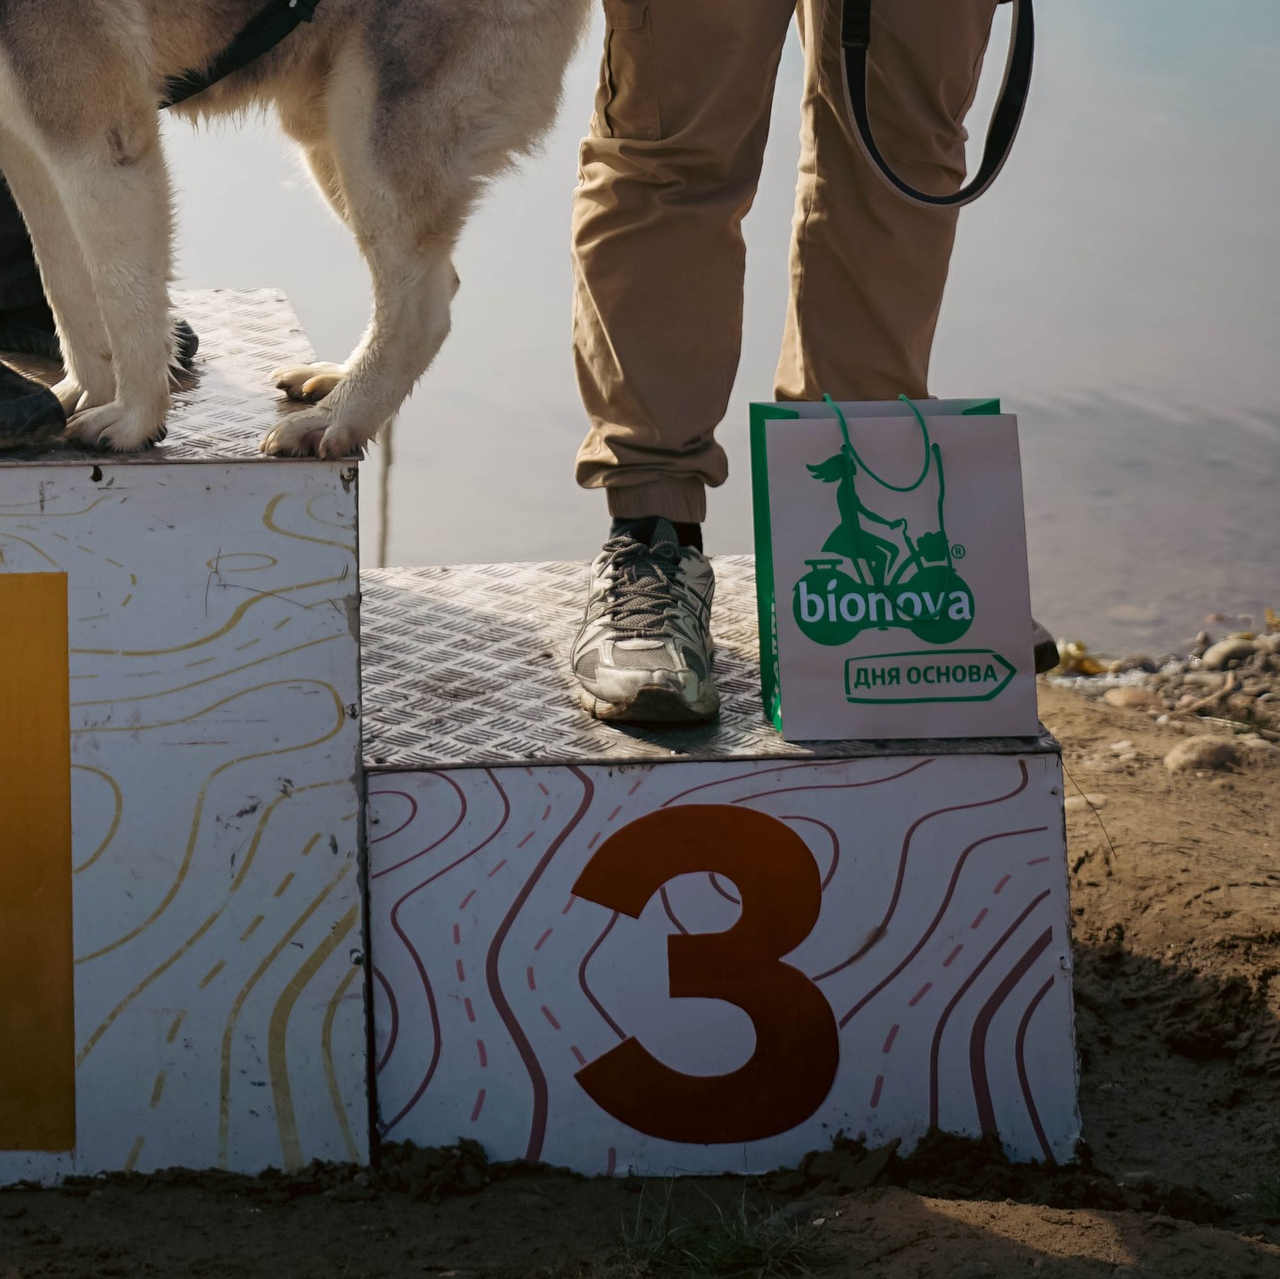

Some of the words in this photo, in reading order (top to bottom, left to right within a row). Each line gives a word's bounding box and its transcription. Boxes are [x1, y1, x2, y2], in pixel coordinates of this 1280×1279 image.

[798, 579, 972, 623] bionova
[854, 667, 901, 690] ДНЯ
[906, 664, 998, 686] ОСНОВА
[574, 802, 838, 1145] 3
